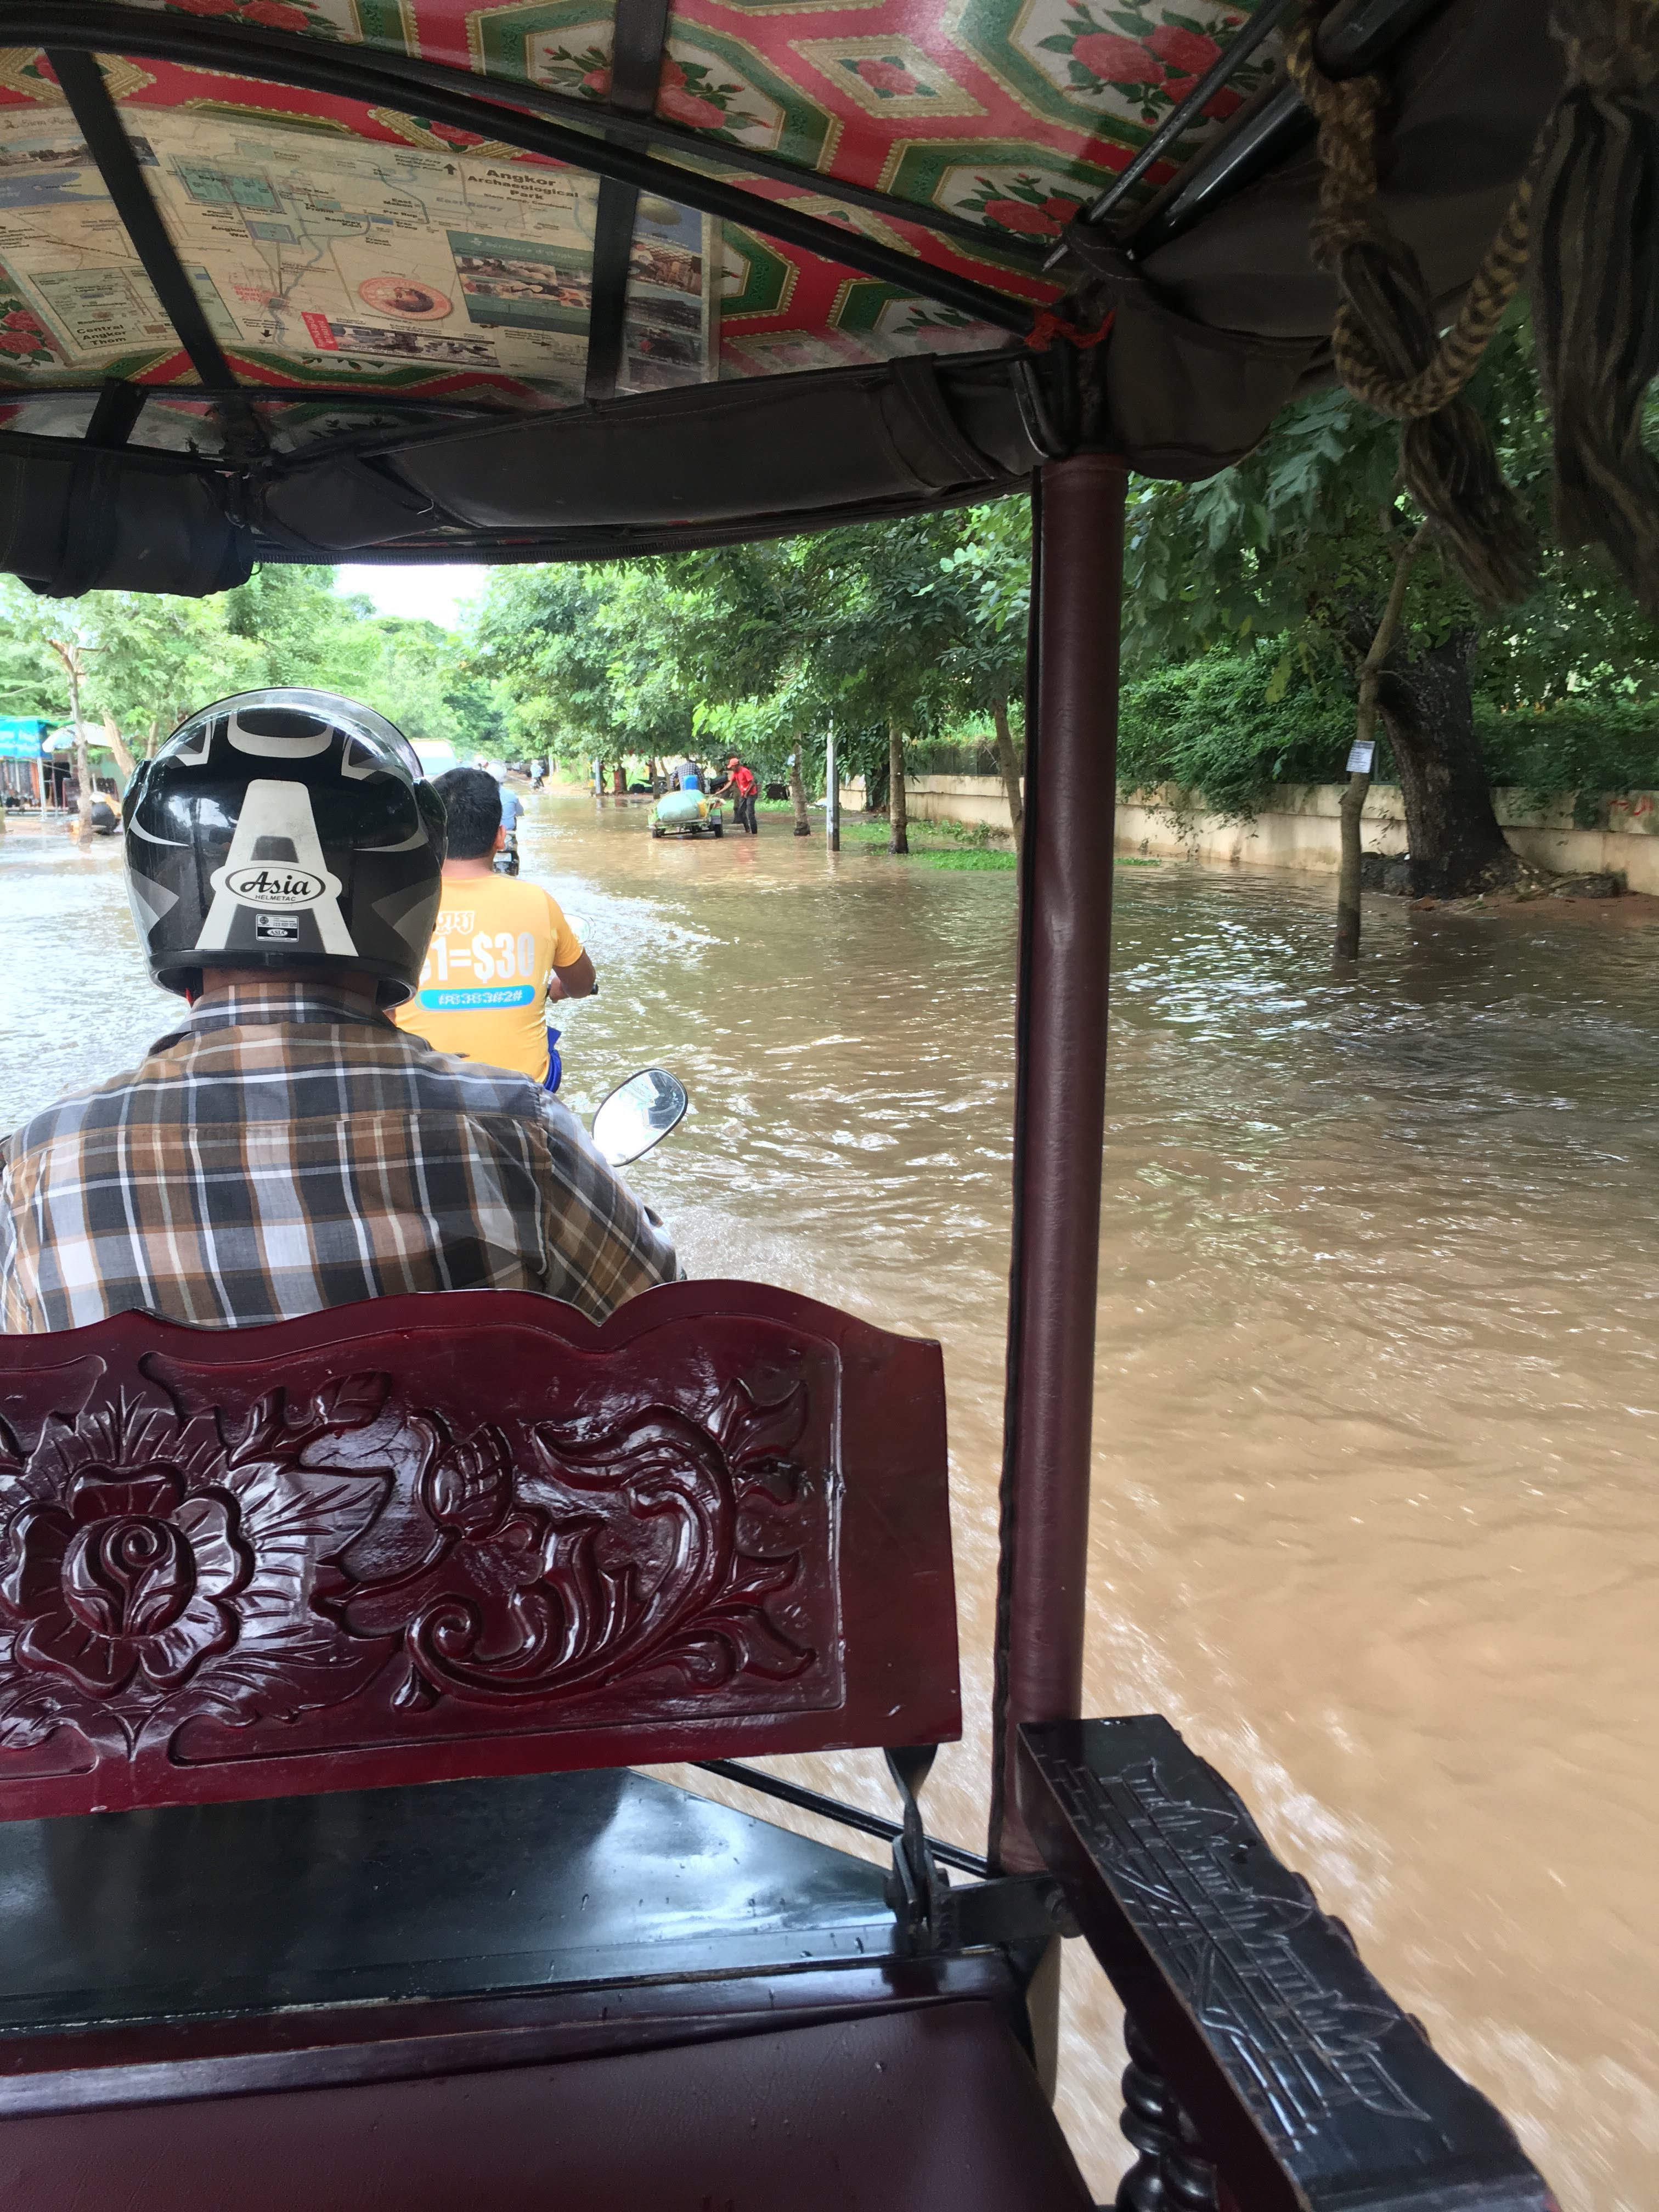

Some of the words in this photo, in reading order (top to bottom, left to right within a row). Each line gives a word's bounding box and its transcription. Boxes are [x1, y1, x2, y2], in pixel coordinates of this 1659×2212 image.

[486, 170, 556, 186] Angkor
[468, 176, 578, 198] Archaeological
[510, 189, 544, 200] Park
[77, 324, 124, 334] Central
[83, 331, 127, 340] Angkor
[89, 337, 127, 346] Thom
[240, 871, 311, 895] Asia
[419, 930, 535, 987] 1=$30
